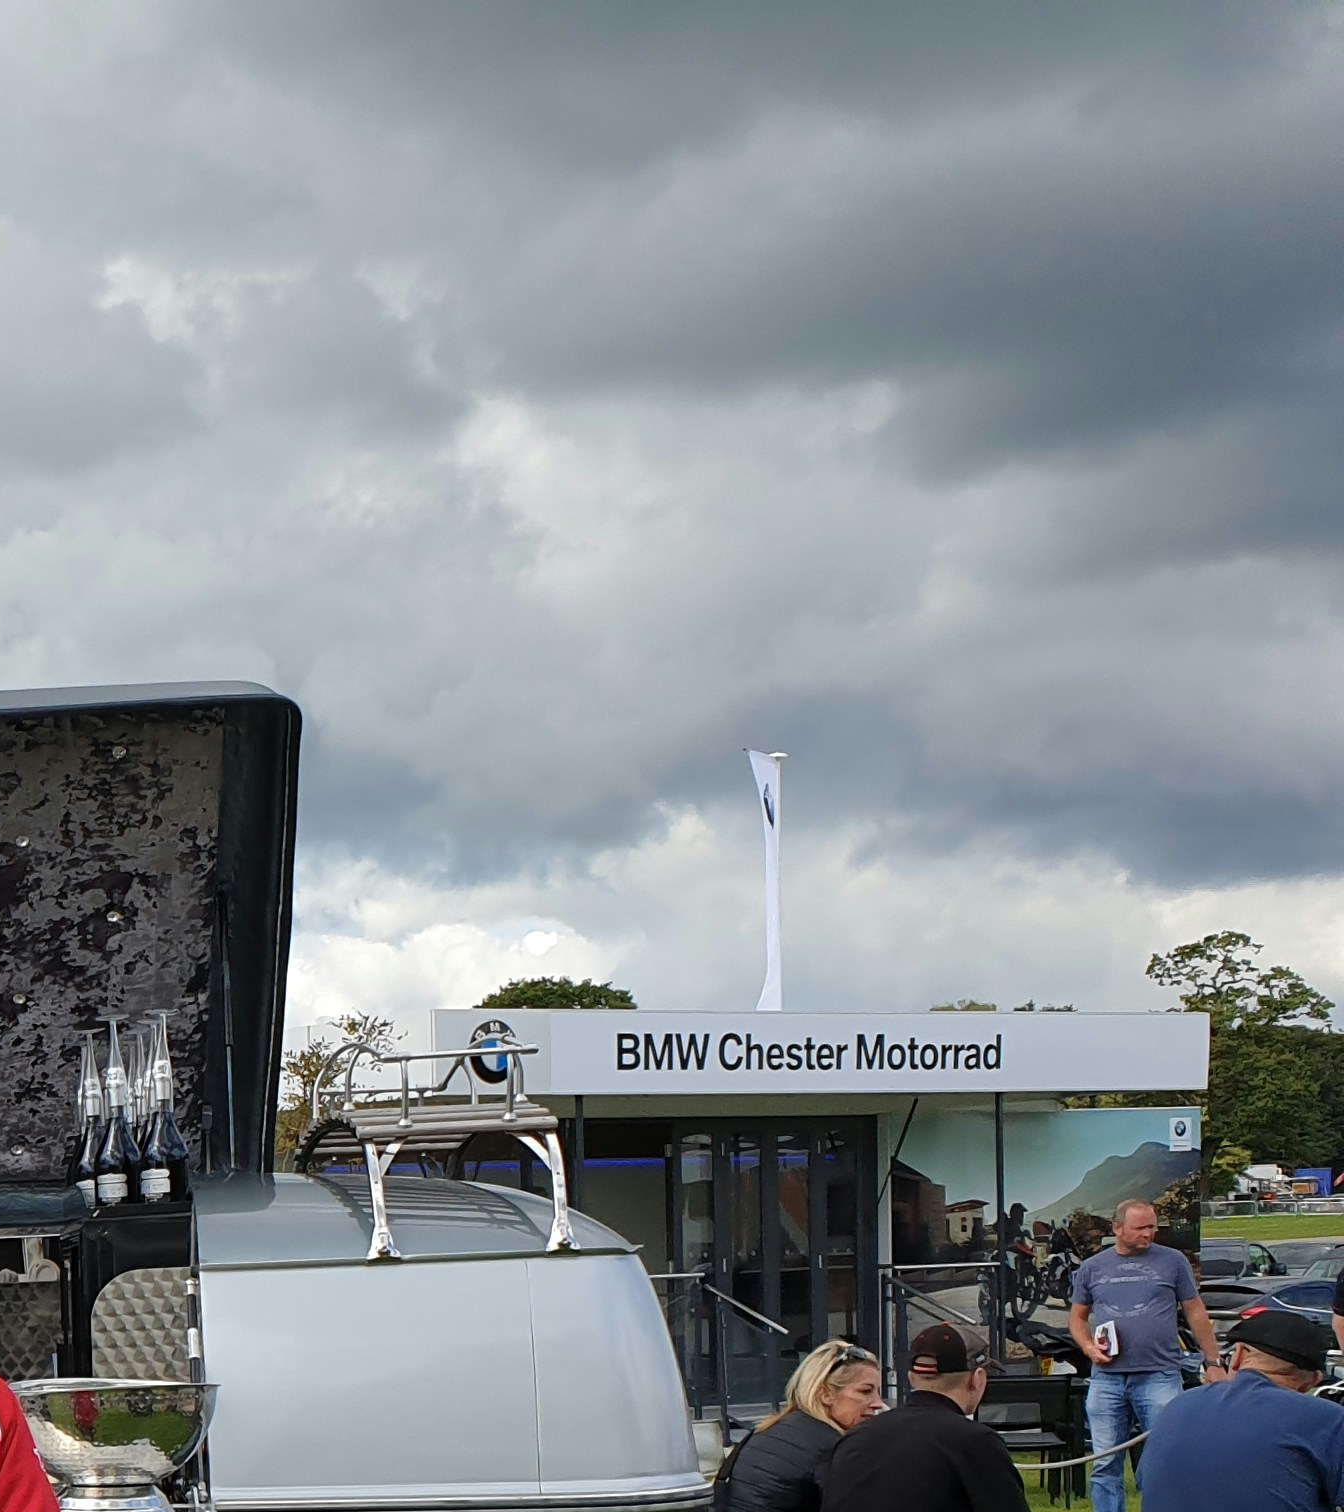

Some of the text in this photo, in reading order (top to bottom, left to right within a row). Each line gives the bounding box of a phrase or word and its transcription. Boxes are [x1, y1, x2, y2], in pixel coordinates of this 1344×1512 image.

[616, 1033, 1002, 1071] BMW Chester Motorrad
